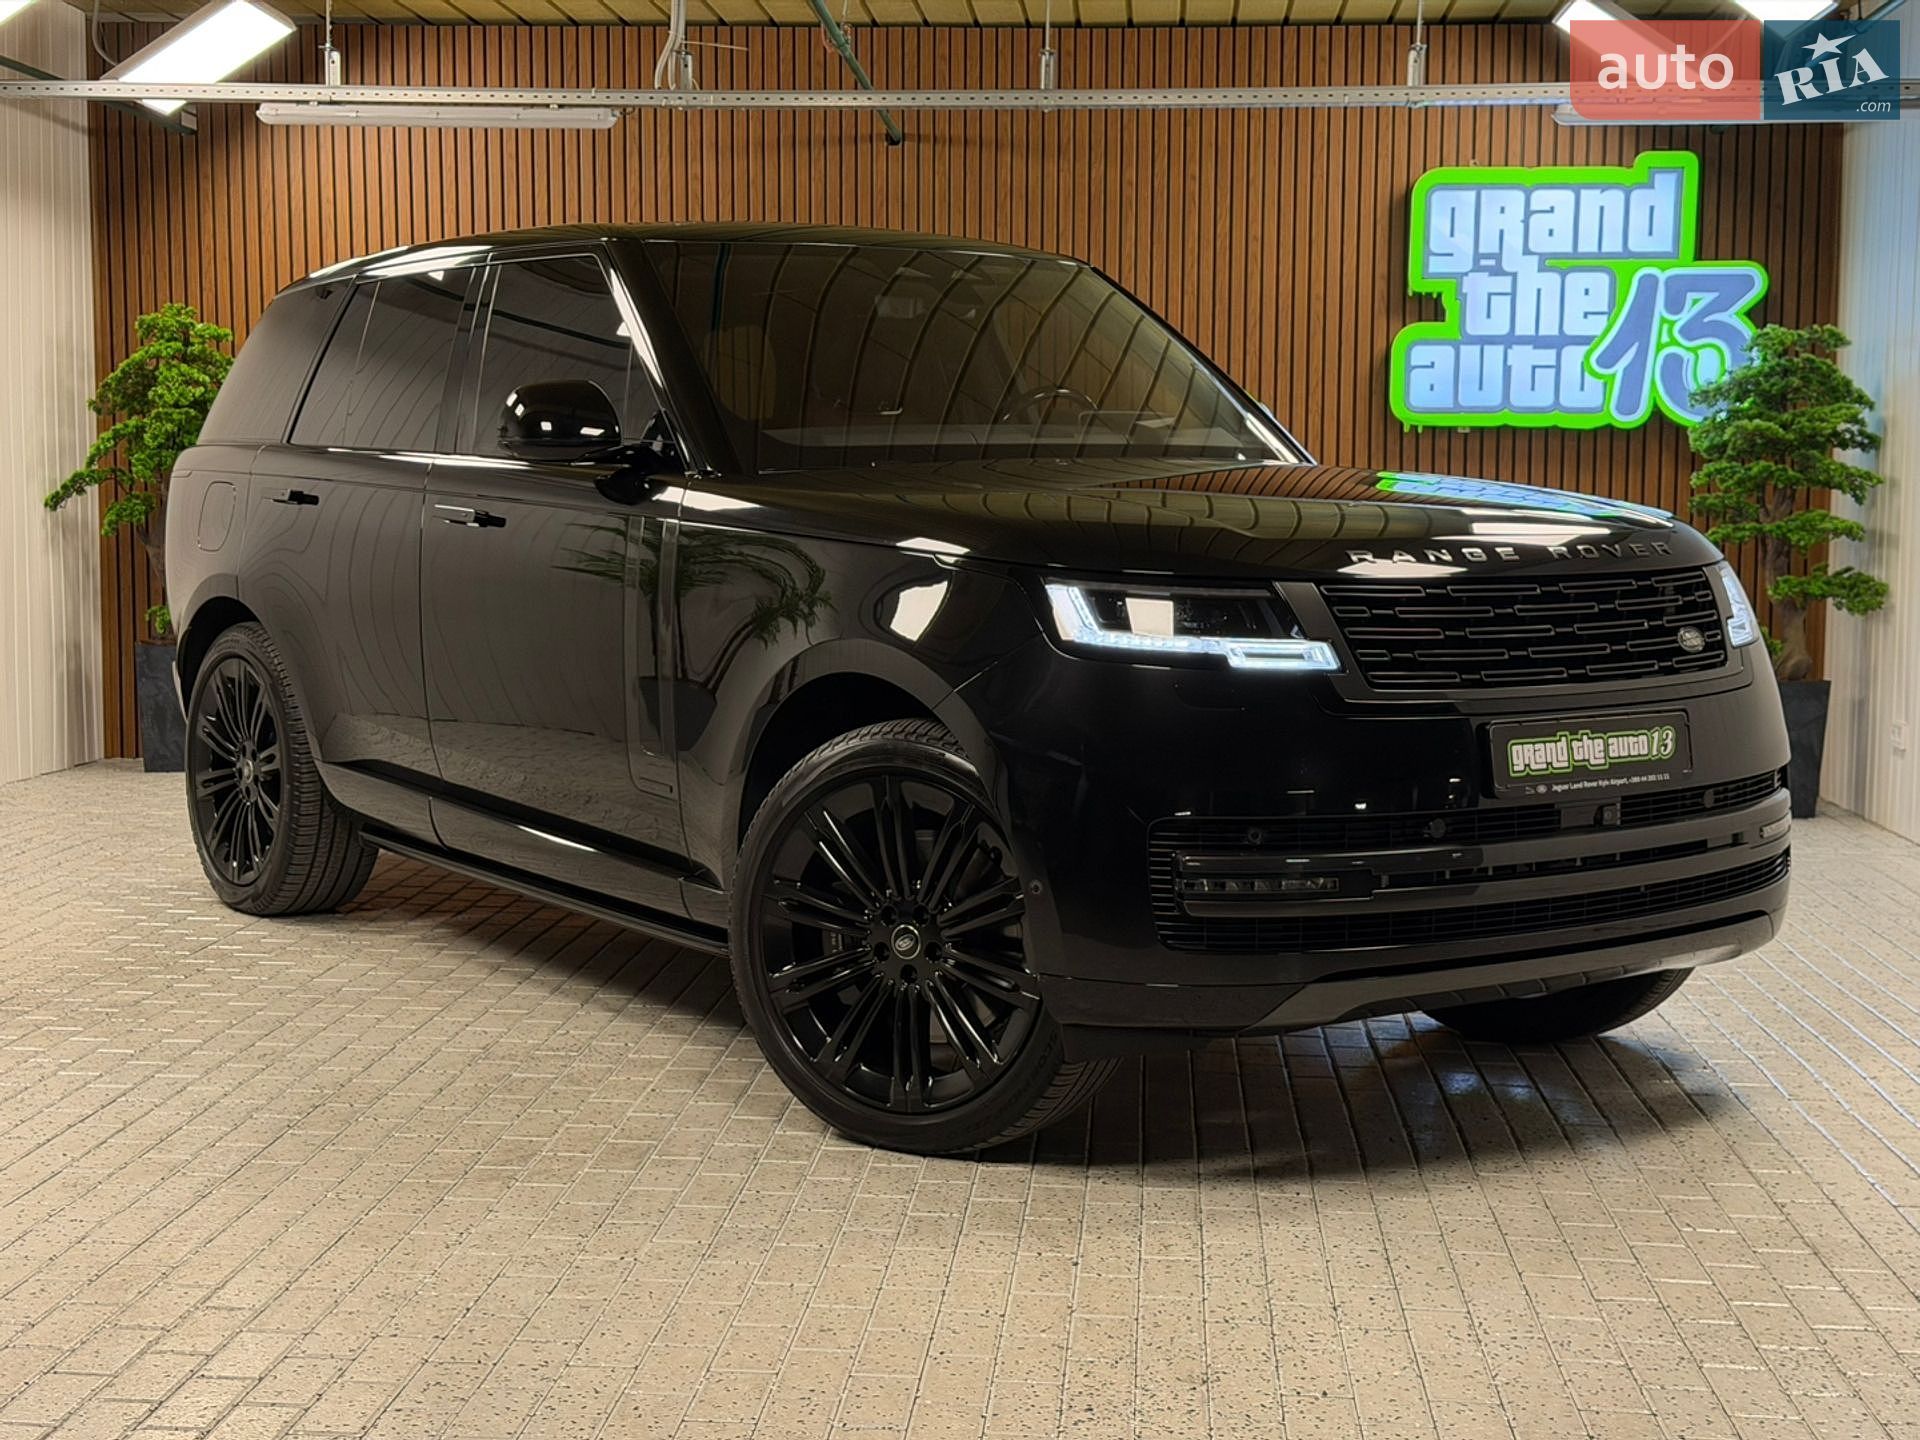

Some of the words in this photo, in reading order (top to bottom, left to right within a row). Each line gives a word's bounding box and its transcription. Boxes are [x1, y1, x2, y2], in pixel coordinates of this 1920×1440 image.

[1461, 256, 1611, 337] the
[1408, 344, 1606, 411] auto
[1590, 267, 1762, 422] 13
[1346, 547, 1521, 564] RANGE
[1548, 541, 1673, 560] ROVER
[1571, 734, 1606, 765] the
[1608, 734, 1649, 758] auto
[1651, 729, 1673, 756] 13
